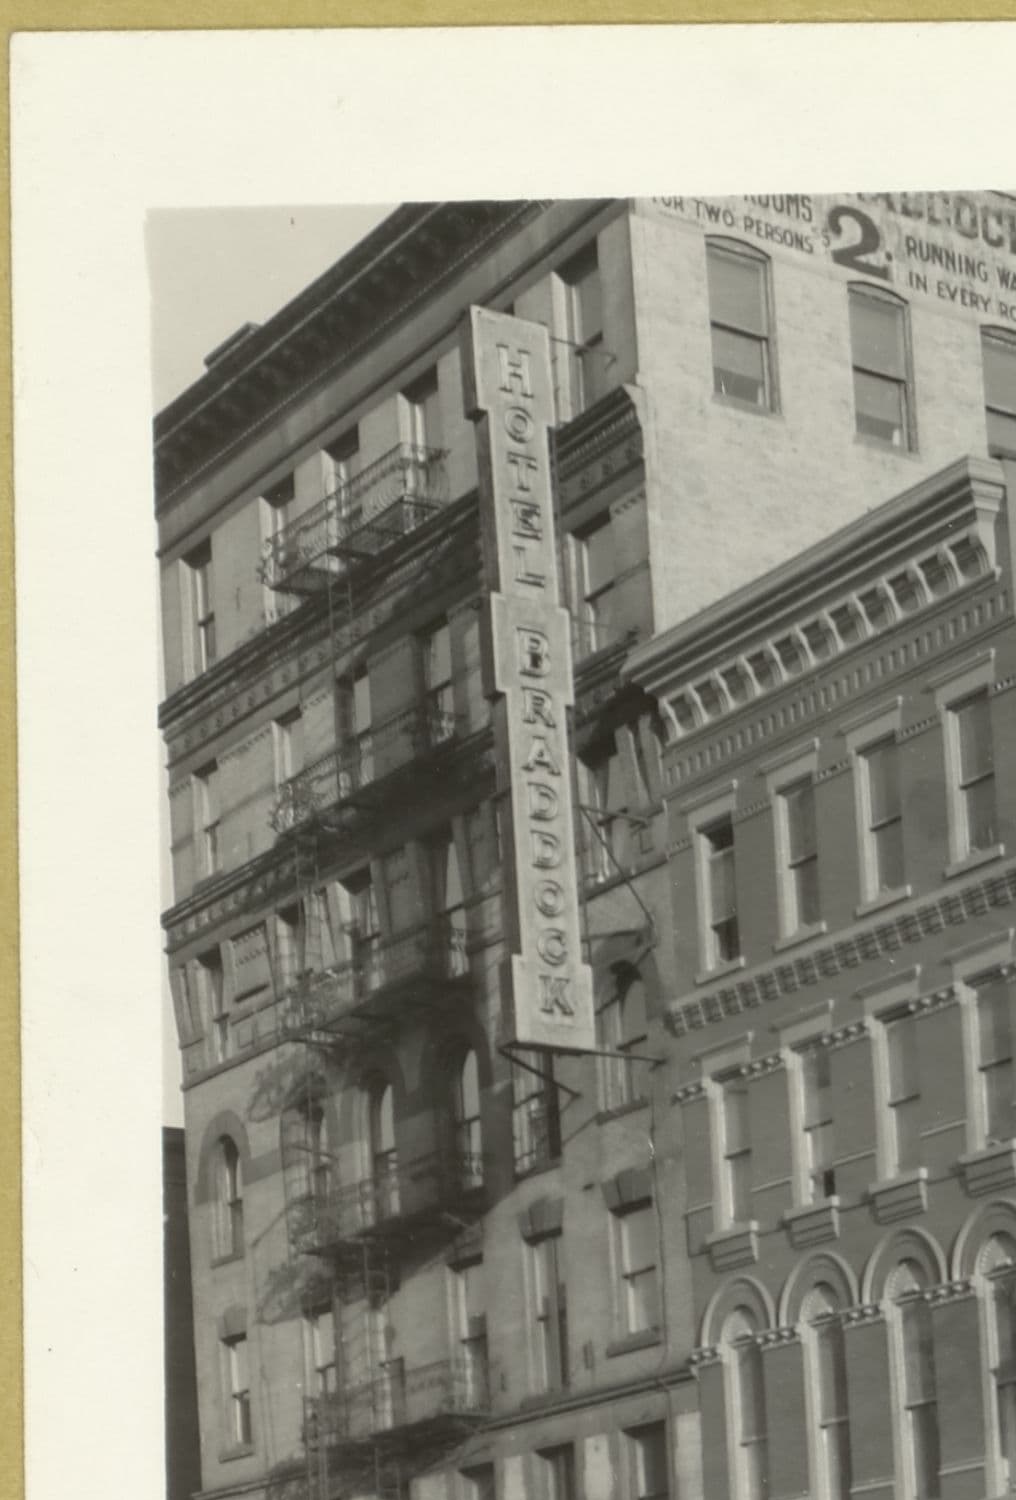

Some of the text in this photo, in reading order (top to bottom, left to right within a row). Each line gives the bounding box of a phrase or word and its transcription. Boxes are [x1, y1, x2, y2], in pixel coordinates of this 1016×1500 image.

[693, 199, 735, 228] TWO
[743, 215, 815, 254] PERSONS
[904, 235, 989, 282] RUNNING
[908, 271, 928, 294] IN
[936, 280, 991, 312] EVERY
[495, 343, 575, 1017] HOTEL BRADDOCK
